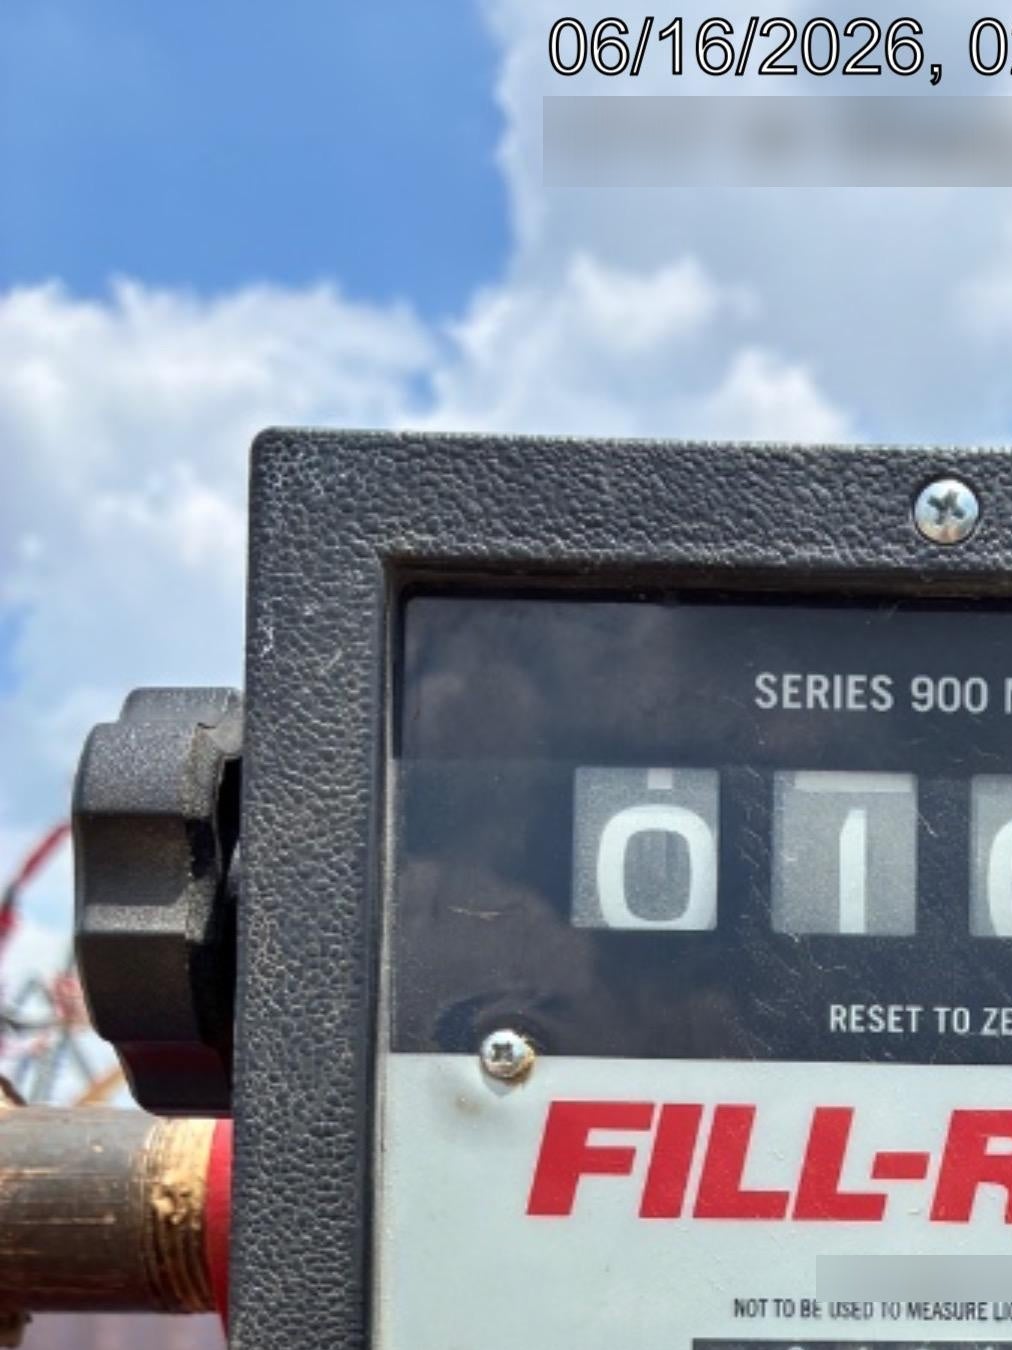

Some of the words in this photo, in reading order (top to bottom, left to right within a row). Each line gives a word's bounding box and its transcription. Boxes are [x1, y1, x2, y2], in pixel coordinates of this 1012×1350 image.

[754, 671, 895, 712] SERIES
[910, 676, 988, 714] 900
[829, 1003, 924, 1033] RESET
[932, 1006, 970, 1034] TO
[733, 1298, 769, 1319] NOT
[774, 1299, 796, 1319] TO
[800, 1299, 823, 1319] BE
[829, 1301, 874, 1320] USED
[880, 1301, 901, 1320] TO
[906, 1301, 988, 1321] MEASURE
